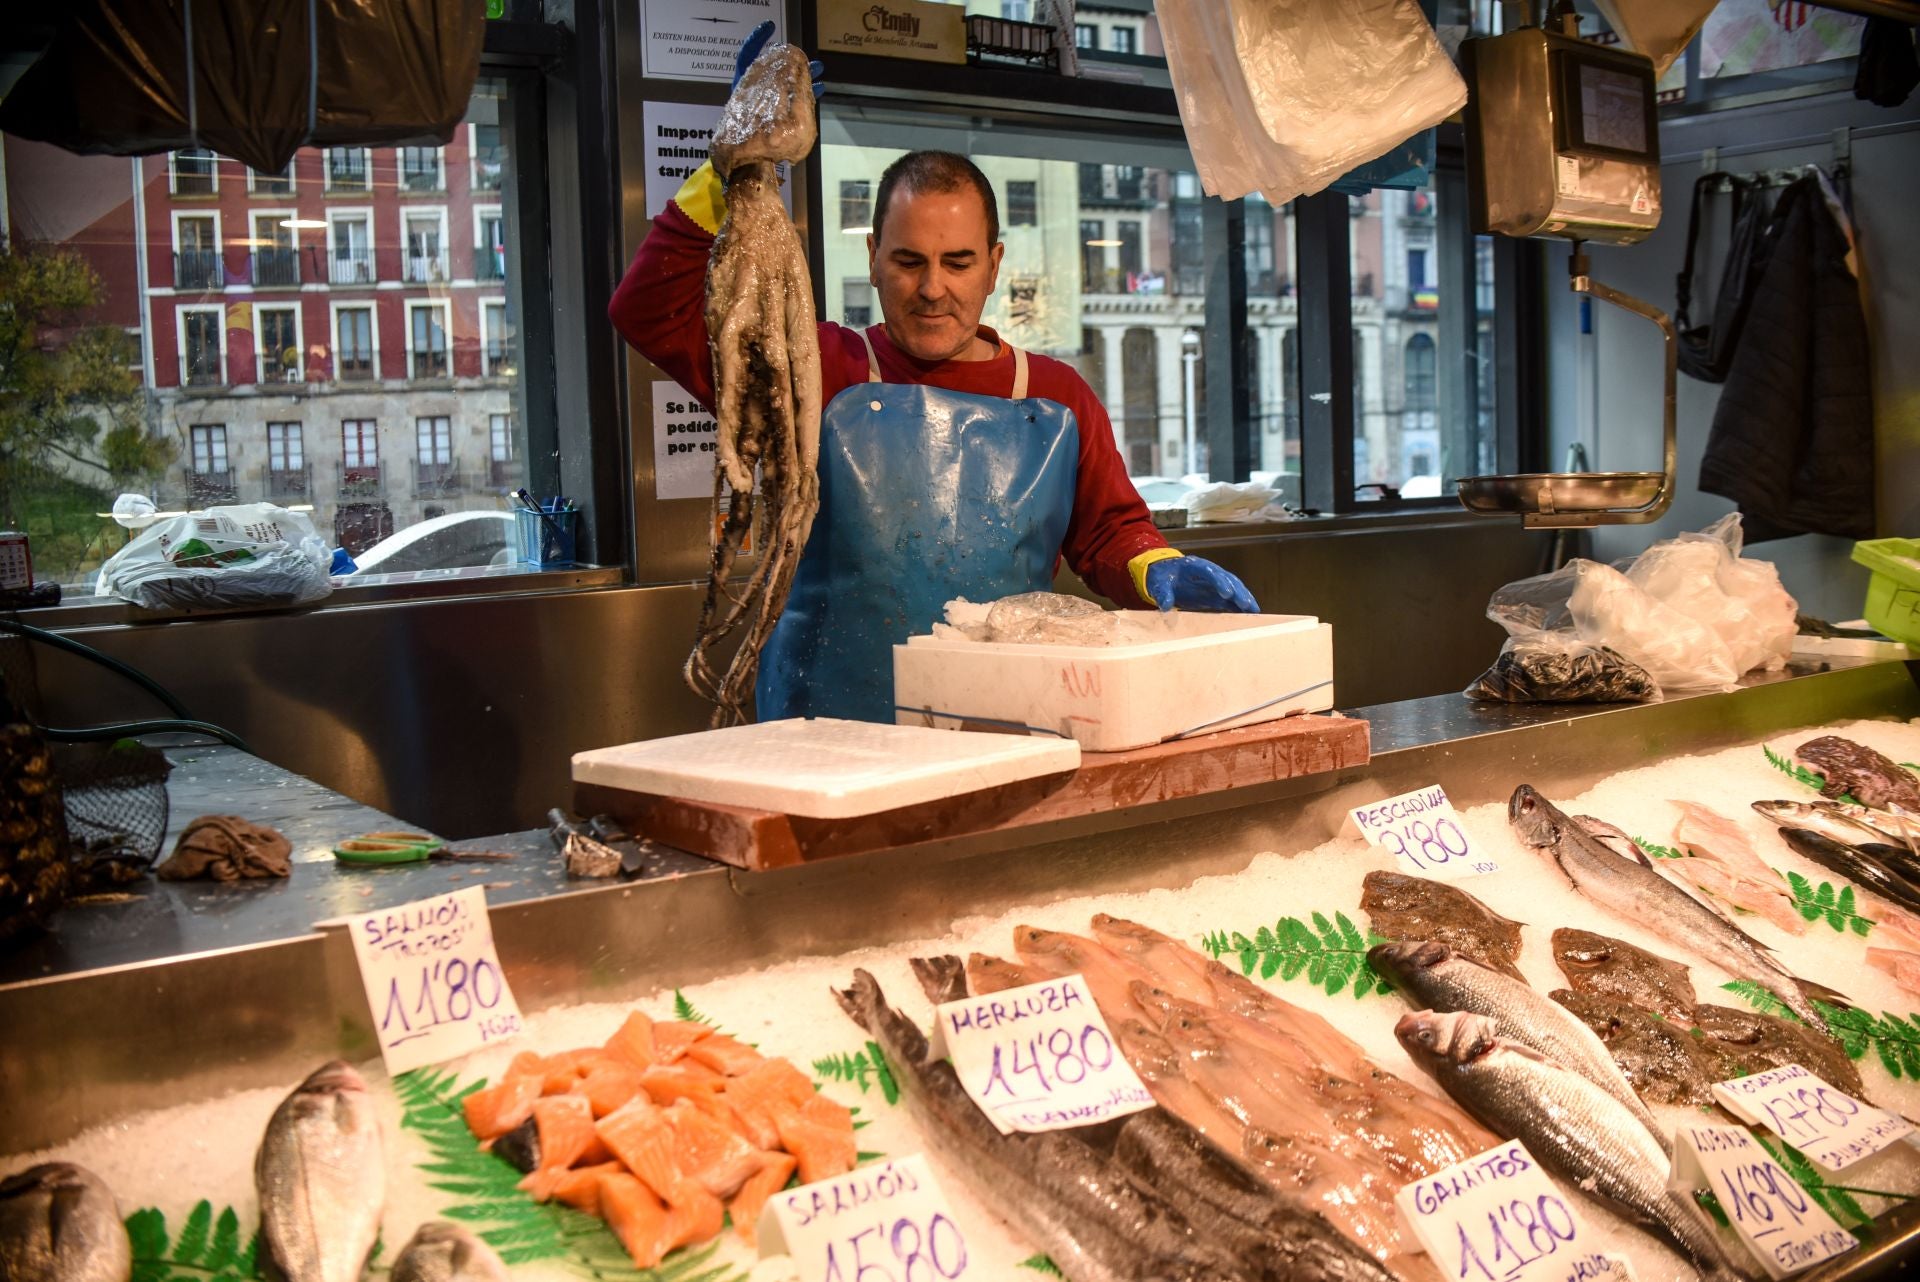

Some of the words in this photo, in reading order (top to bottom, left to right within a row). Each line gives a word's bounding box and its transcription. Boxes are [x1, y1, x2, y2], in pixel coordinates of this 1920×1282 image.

[880, 10, 921, 37] Emily
[652, 32, 683, 41] EXISTEN
[683, 34, 707, 43] HOJAS
[675, 47, 720, 57] DISPOSICIÓN
[657, 125, 715, 141] Import
[657, 146, 710, 159] mínim
[666, 402, 685, 413] Se
[668, 442, 696, 455] por
[382, 958, 502, 1032] 11'80
[951, 983, 1083, 1034] MERLUZA
[983, 1024, 1112, 1096] 14'80
[1761, 1088, 1858, 1138] 17'80
[788, 1163, 918, 1226] SALMÓN
[1456, 1194, 1576, 1282] 11'80
